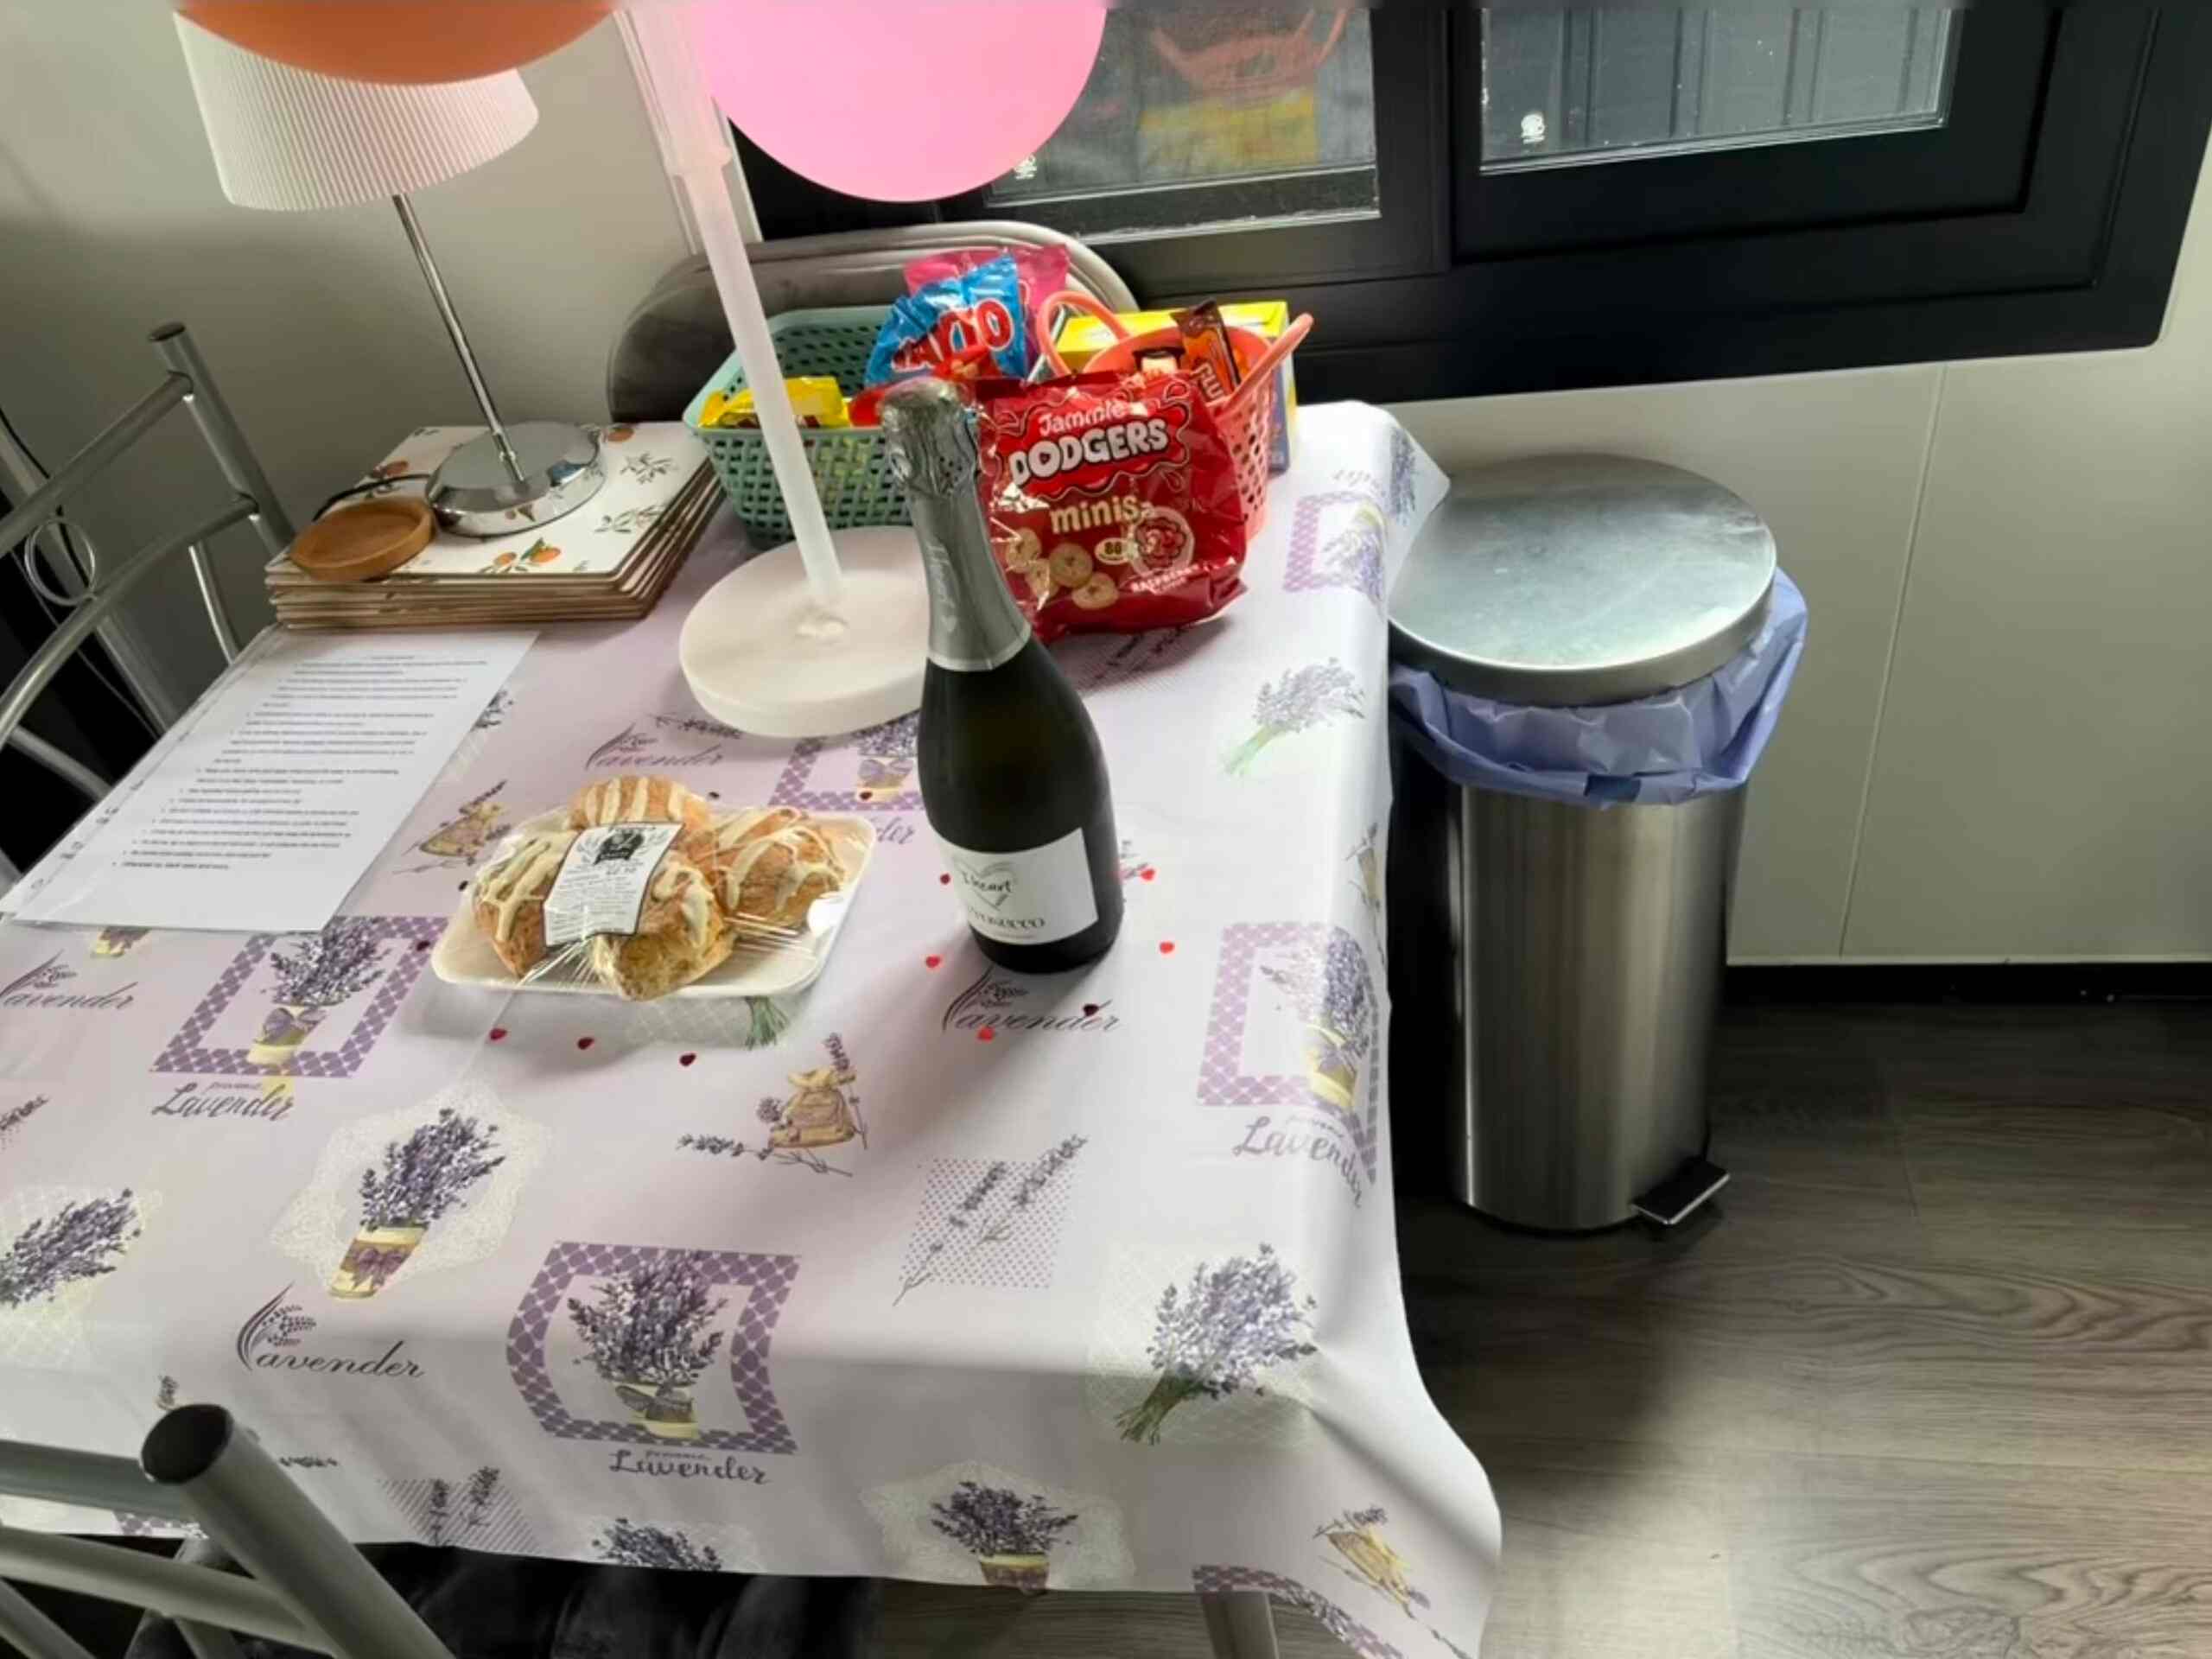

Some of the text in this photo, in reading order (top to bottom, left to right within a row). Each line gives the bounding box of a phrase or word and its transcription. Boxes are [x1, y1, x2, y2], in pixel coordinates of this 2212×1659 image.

[1039, 399, 1127, 435] Jammie
[1007, 417, 1170, 488] DODGERS
[1049, 494, 1142, 535] minis
[151, 1082, 296, 1122] Lavender
[608, 1448, 774, 1485] Lavender
